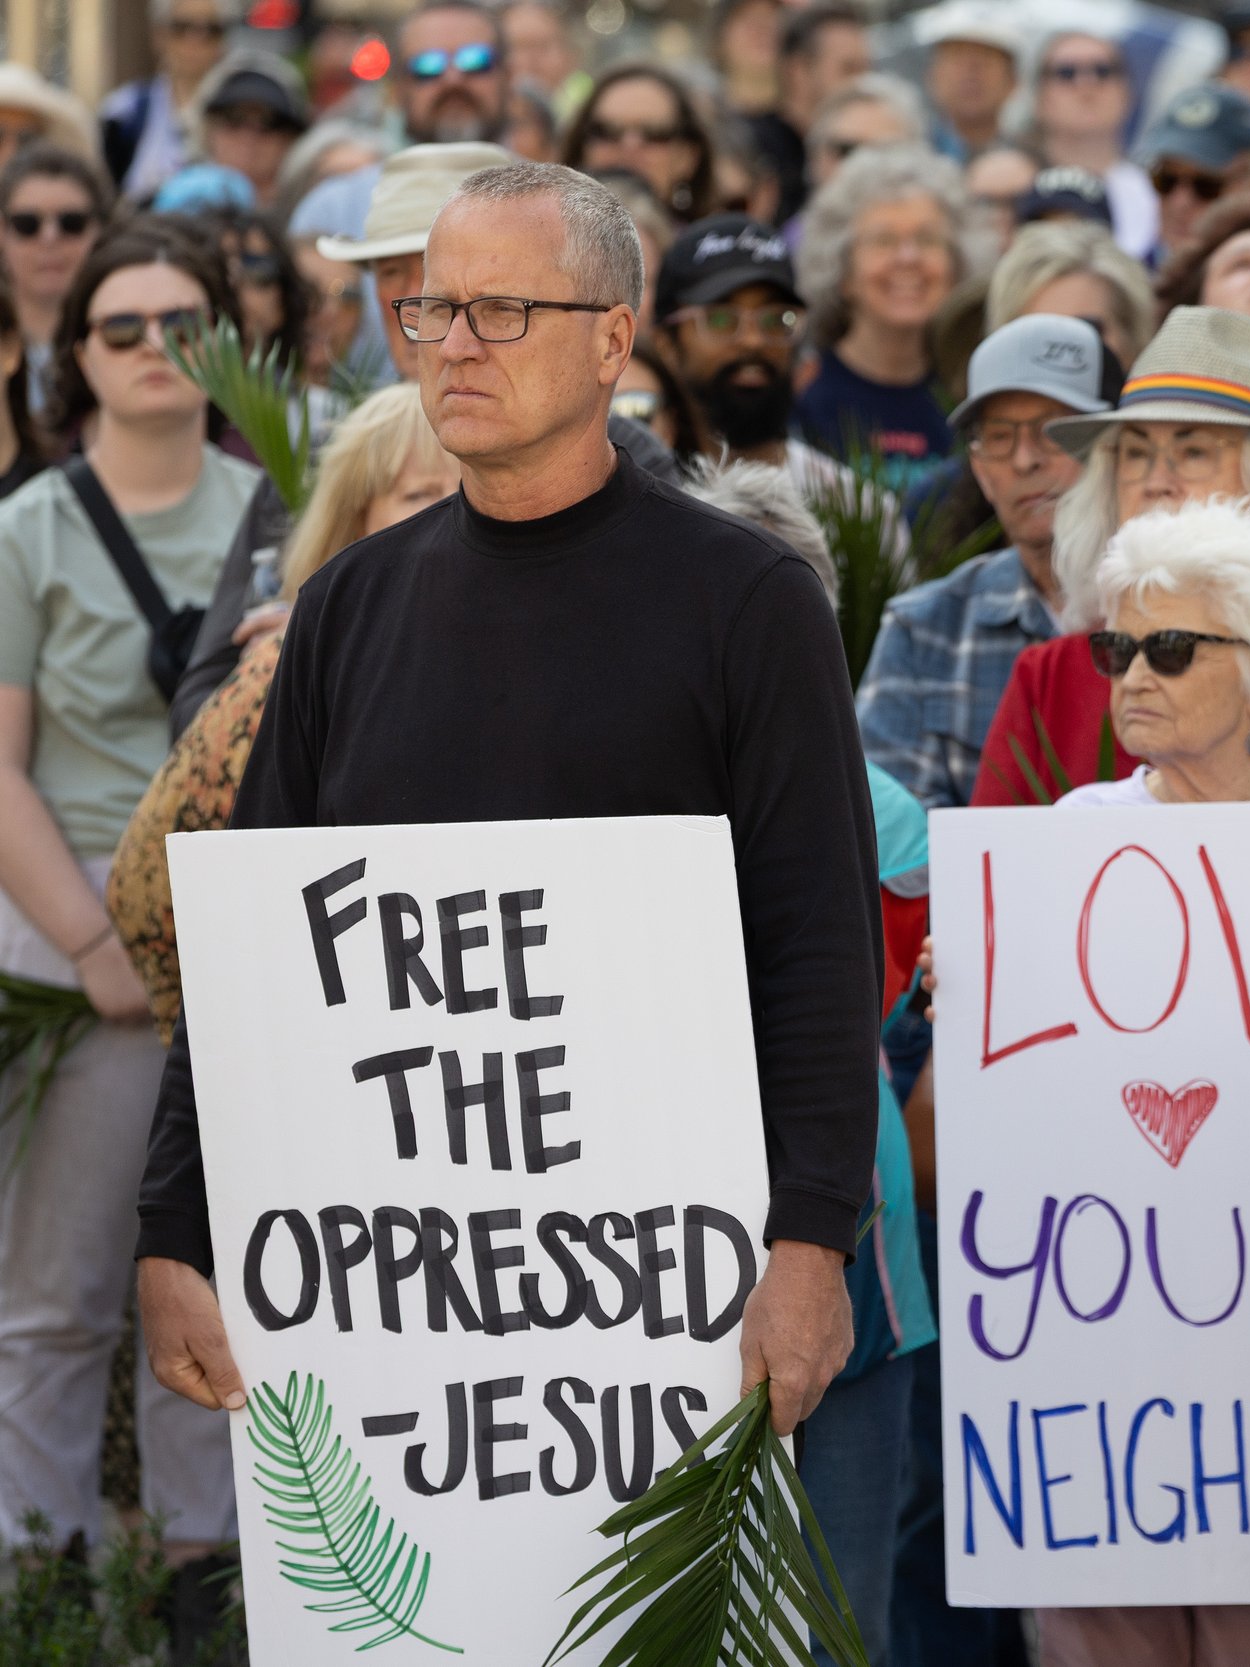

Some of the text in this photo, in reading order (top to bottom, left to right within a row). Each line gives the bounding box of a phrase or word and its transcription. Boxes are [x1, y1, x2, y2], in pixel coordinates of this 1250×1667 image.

[302, 857, 564, 1021] FREE
[352, 1045, 581, 1174] THE
[244, 1205, 757, 1343] OPPRESSED
[362, 1376, 708, 1502] -JESUS
